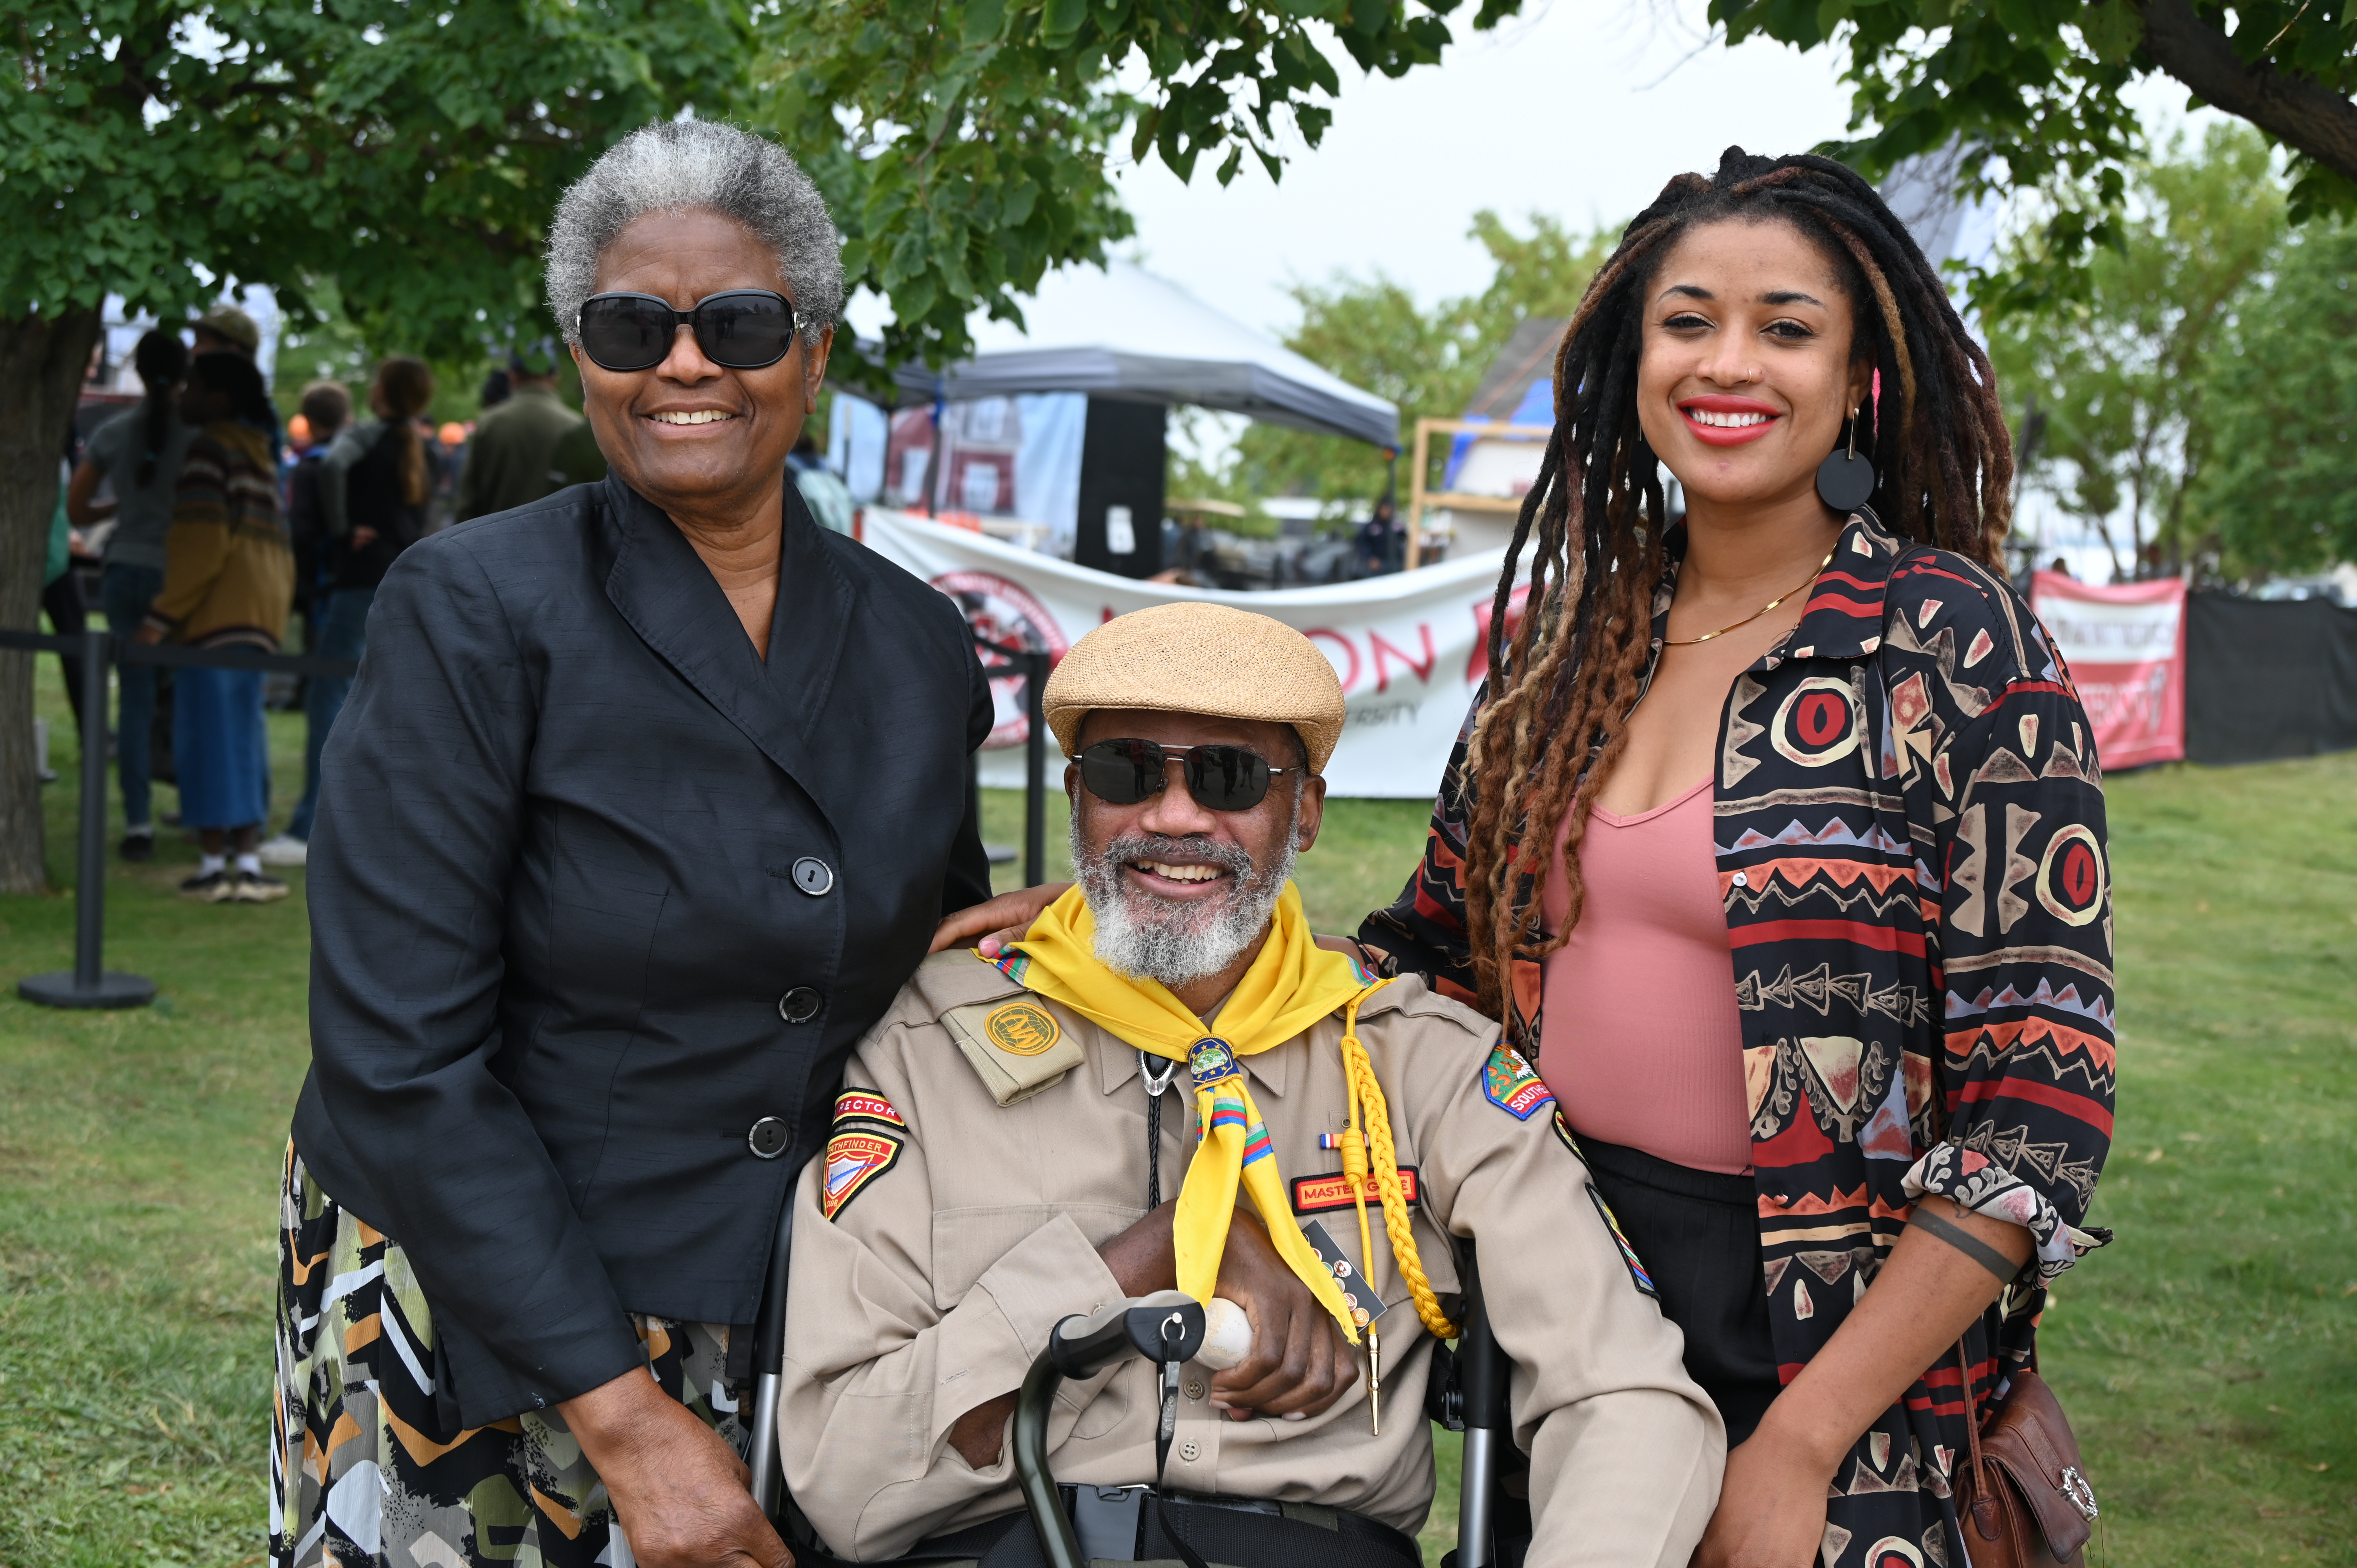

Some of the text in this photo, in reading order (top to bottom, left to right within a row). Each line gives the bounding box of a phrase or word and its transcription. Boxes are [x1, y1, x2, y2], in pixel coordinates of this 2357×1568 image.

[827, 1139, 882, 1155] PATHFINDER
[1304, 1184, 1355, 1200] MASTE
[826, 1199, 838, 1208] CLUB
